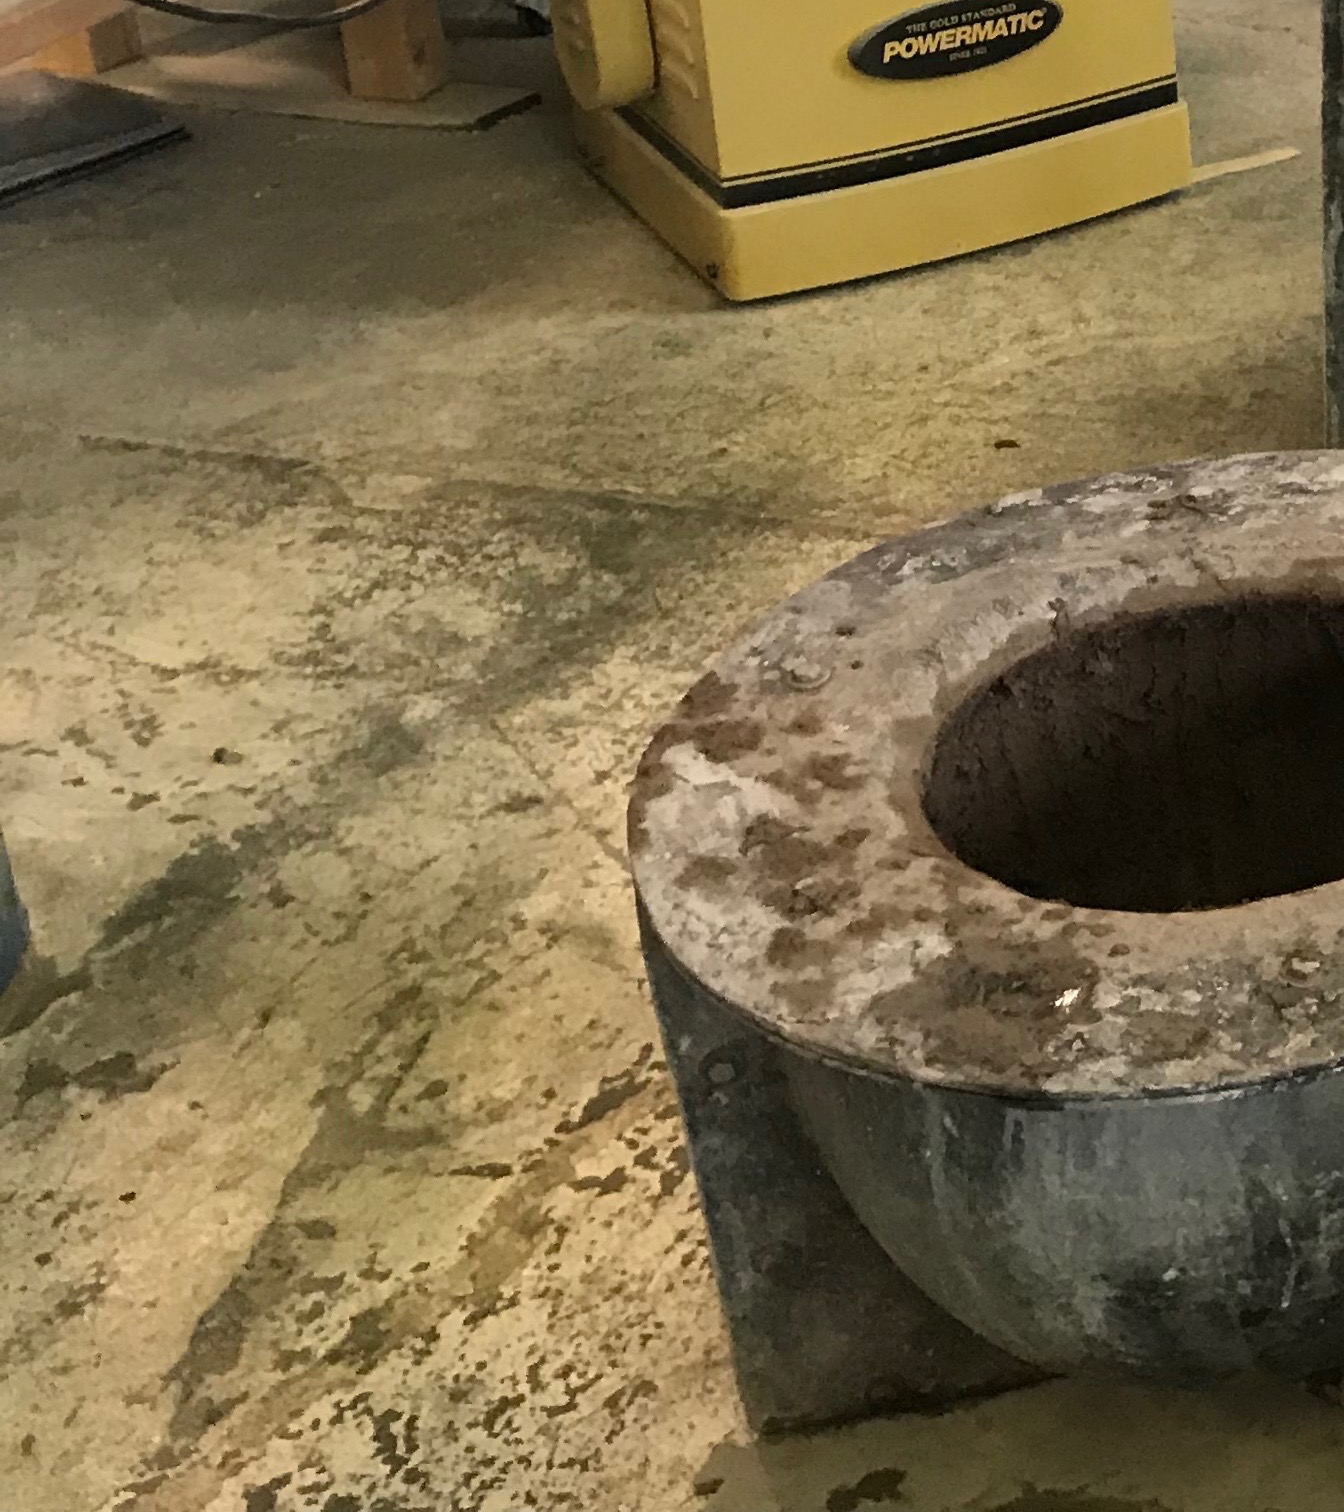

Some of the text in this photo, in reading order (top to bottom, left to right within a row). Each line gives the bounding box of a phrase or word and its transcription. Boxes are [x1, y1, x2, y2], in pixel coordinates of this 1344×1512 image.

[882, 9, 1045, 65] POWERMATIC
[906, 3, 1018, 34] THE GOLD STANDARD
